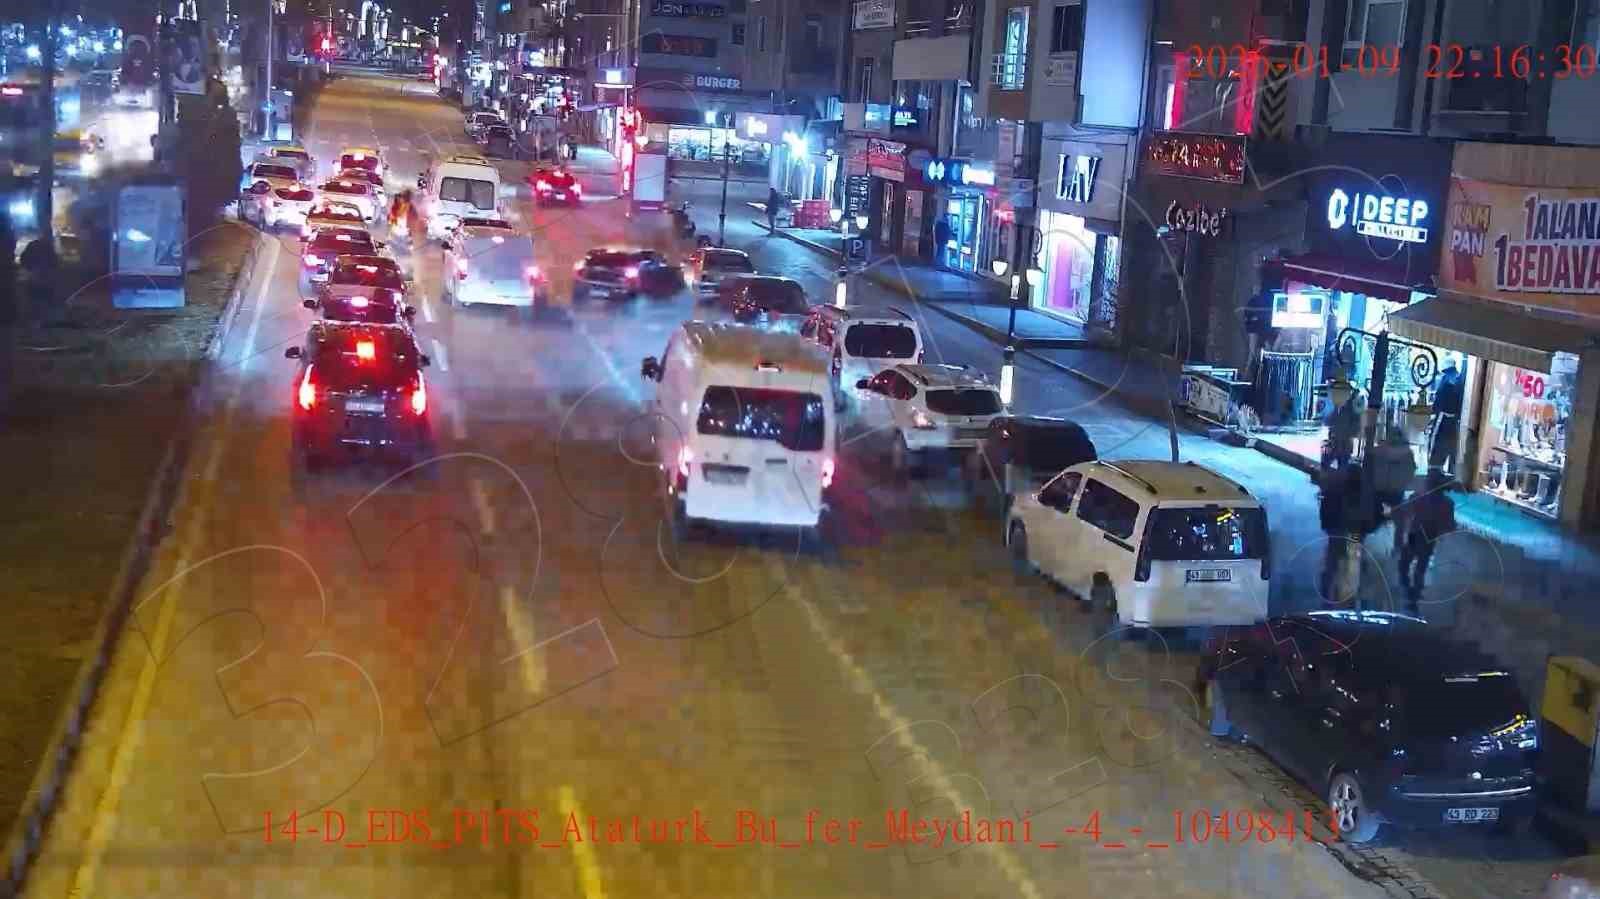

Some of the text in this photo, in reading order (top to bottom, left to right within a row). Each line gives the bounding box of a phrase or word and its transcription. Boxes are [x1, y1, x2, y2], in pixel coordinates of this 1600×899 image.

[696, 76, 742, 90] BURGER
[1056, 153, 1100, 203] LAV
[1363, 194, 1429, 226] DEEP
[1451, 229, 1484, 256] PAN
